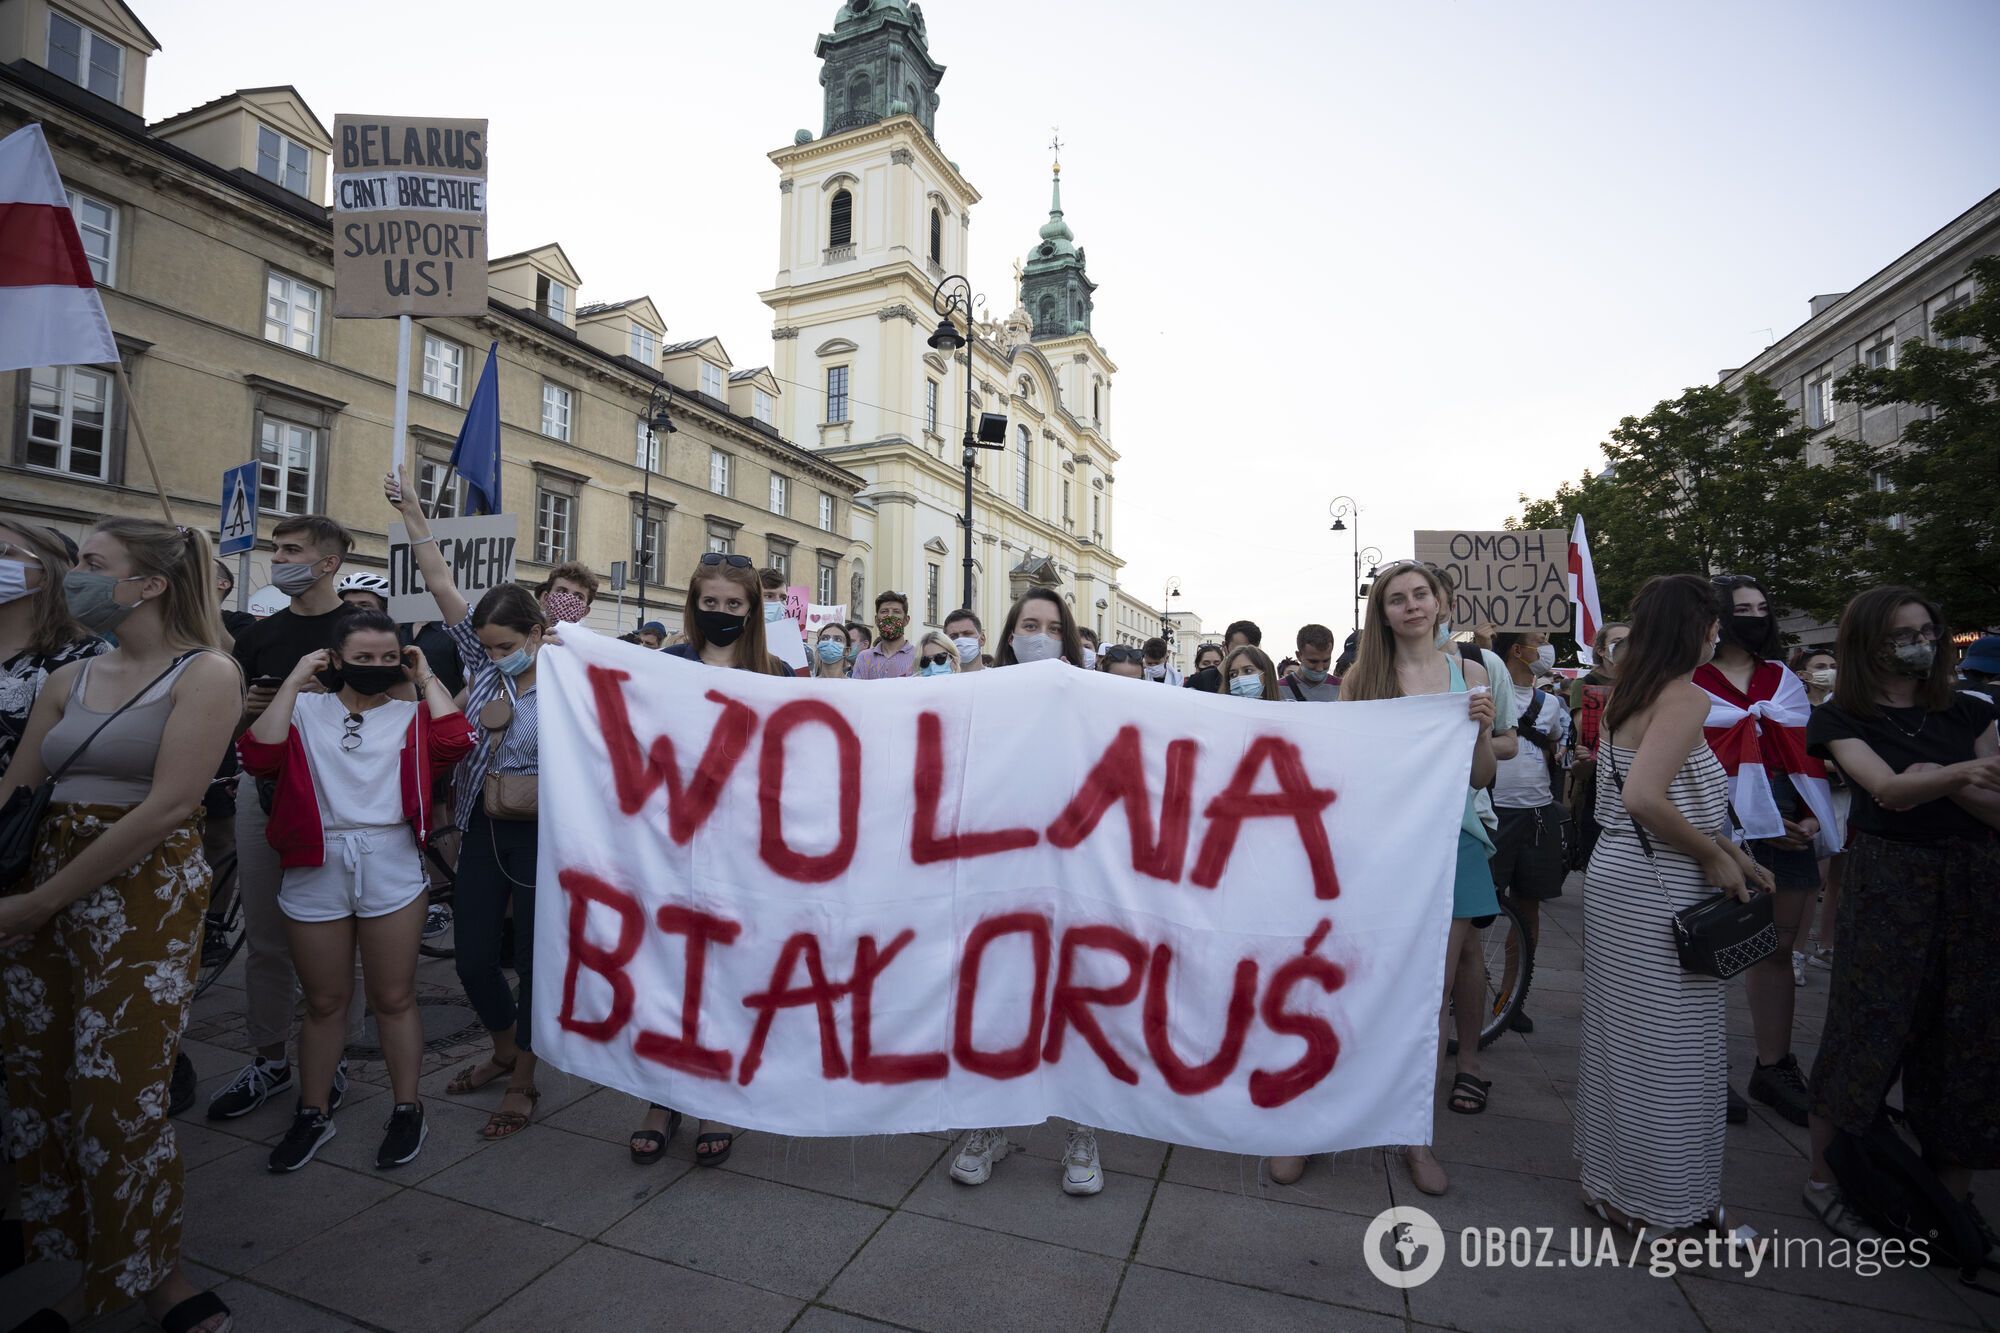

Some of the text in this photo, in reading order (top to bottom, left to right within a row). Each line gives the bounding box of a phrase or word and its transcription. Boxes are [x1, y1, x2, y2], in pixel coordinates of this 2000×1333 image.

[342, 125, 483, 171] BELARUS
[340, 176, 483, 211] CAN'T BREATHE
[343, 219, 483, 259] SUPPORT
[384, 258, 454, 298] US!
[1451, 593, 1570, 628] DNO ZŁO
[586, 662, 1340, 900] WOLNA
[557, 867, 1347, 1109] BIAŁORUŚ
